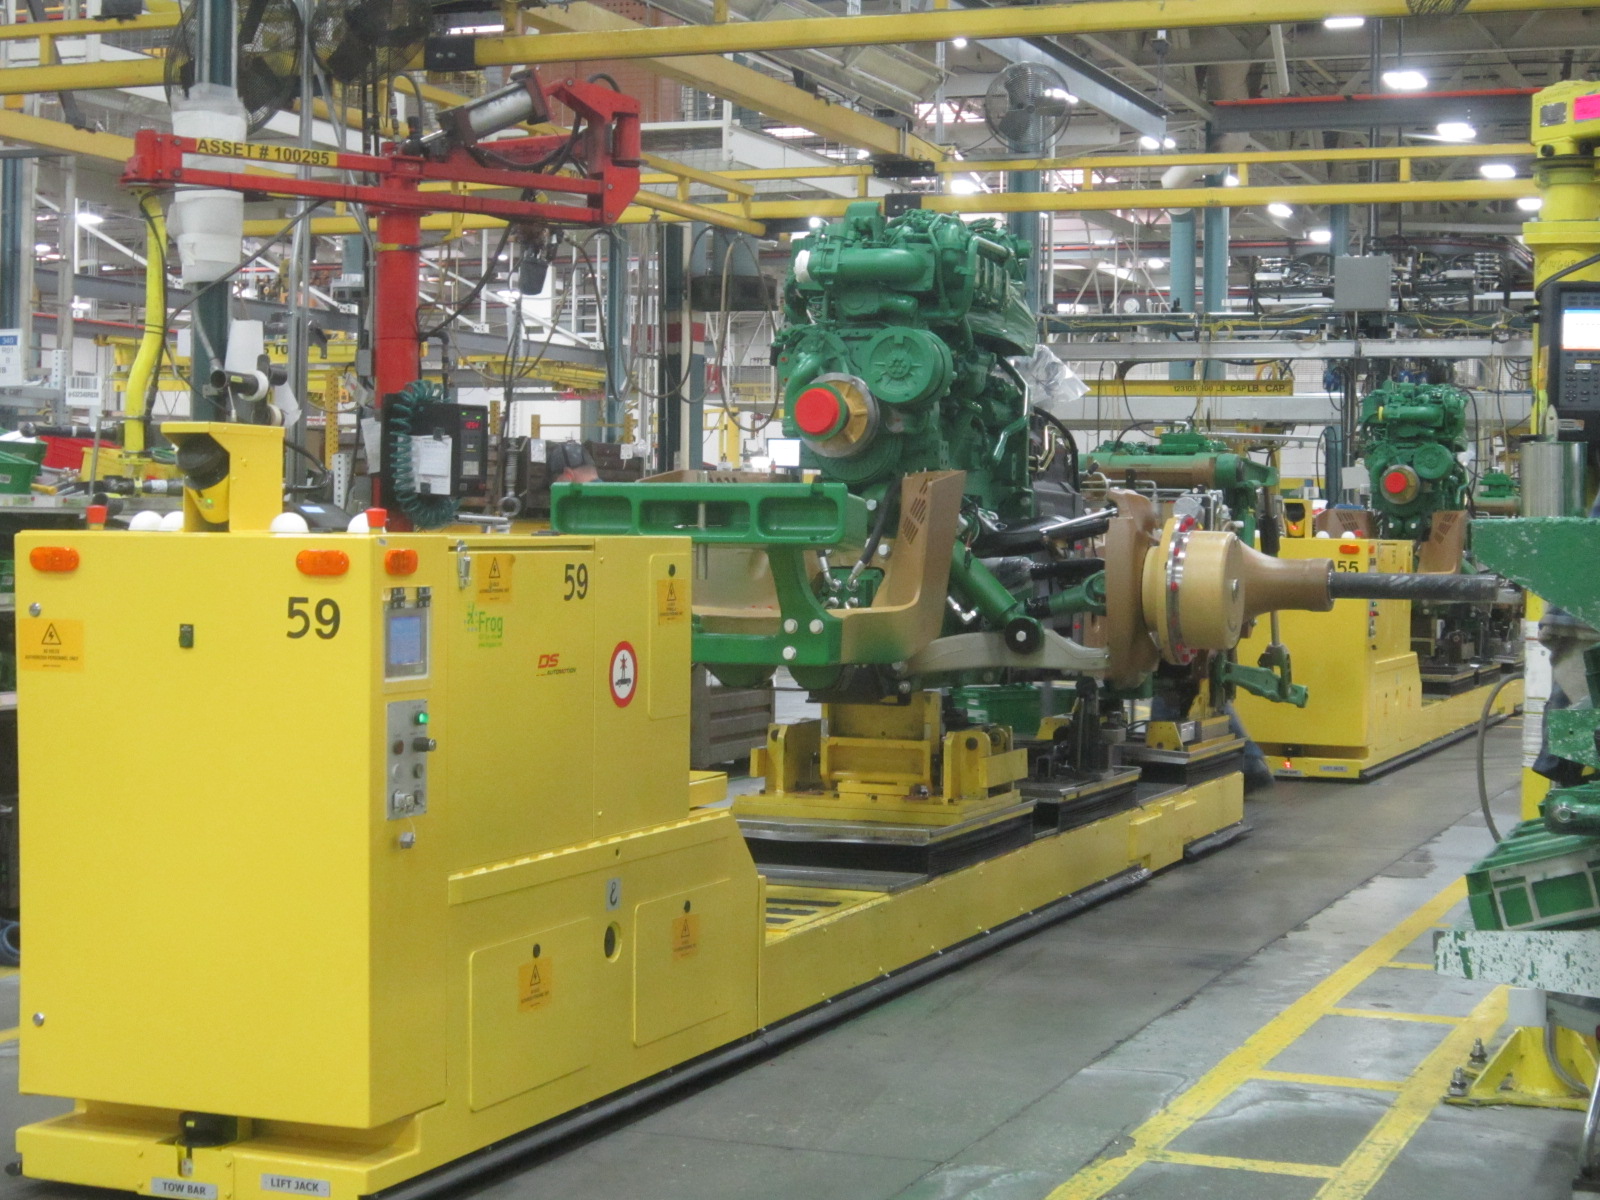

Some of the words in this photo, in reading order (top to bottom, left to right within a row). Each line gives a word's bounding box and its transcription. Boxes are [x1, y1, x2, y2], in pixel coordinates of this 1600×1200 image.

[198, 138, 254, 158] ASSET
[260, 145, 269, 159] #
[275, 147, 329, 166] 100295
[1247, 385, 1261, 393] LB.
[1265, 385, 1286, 393] CAP.
[564, 563, 588, 601] 59
[286, 597, 341, 640] 59
[479, 611, 503, 639] Frog
[538, 653, 560, 669] DS
[162, 1181, 185, 1193] TOW
[187, 1186, 207, 1195] BAR
[271, 1178, 292, 1189] LIFT
[295, 1181, 319, 1192] JACK
